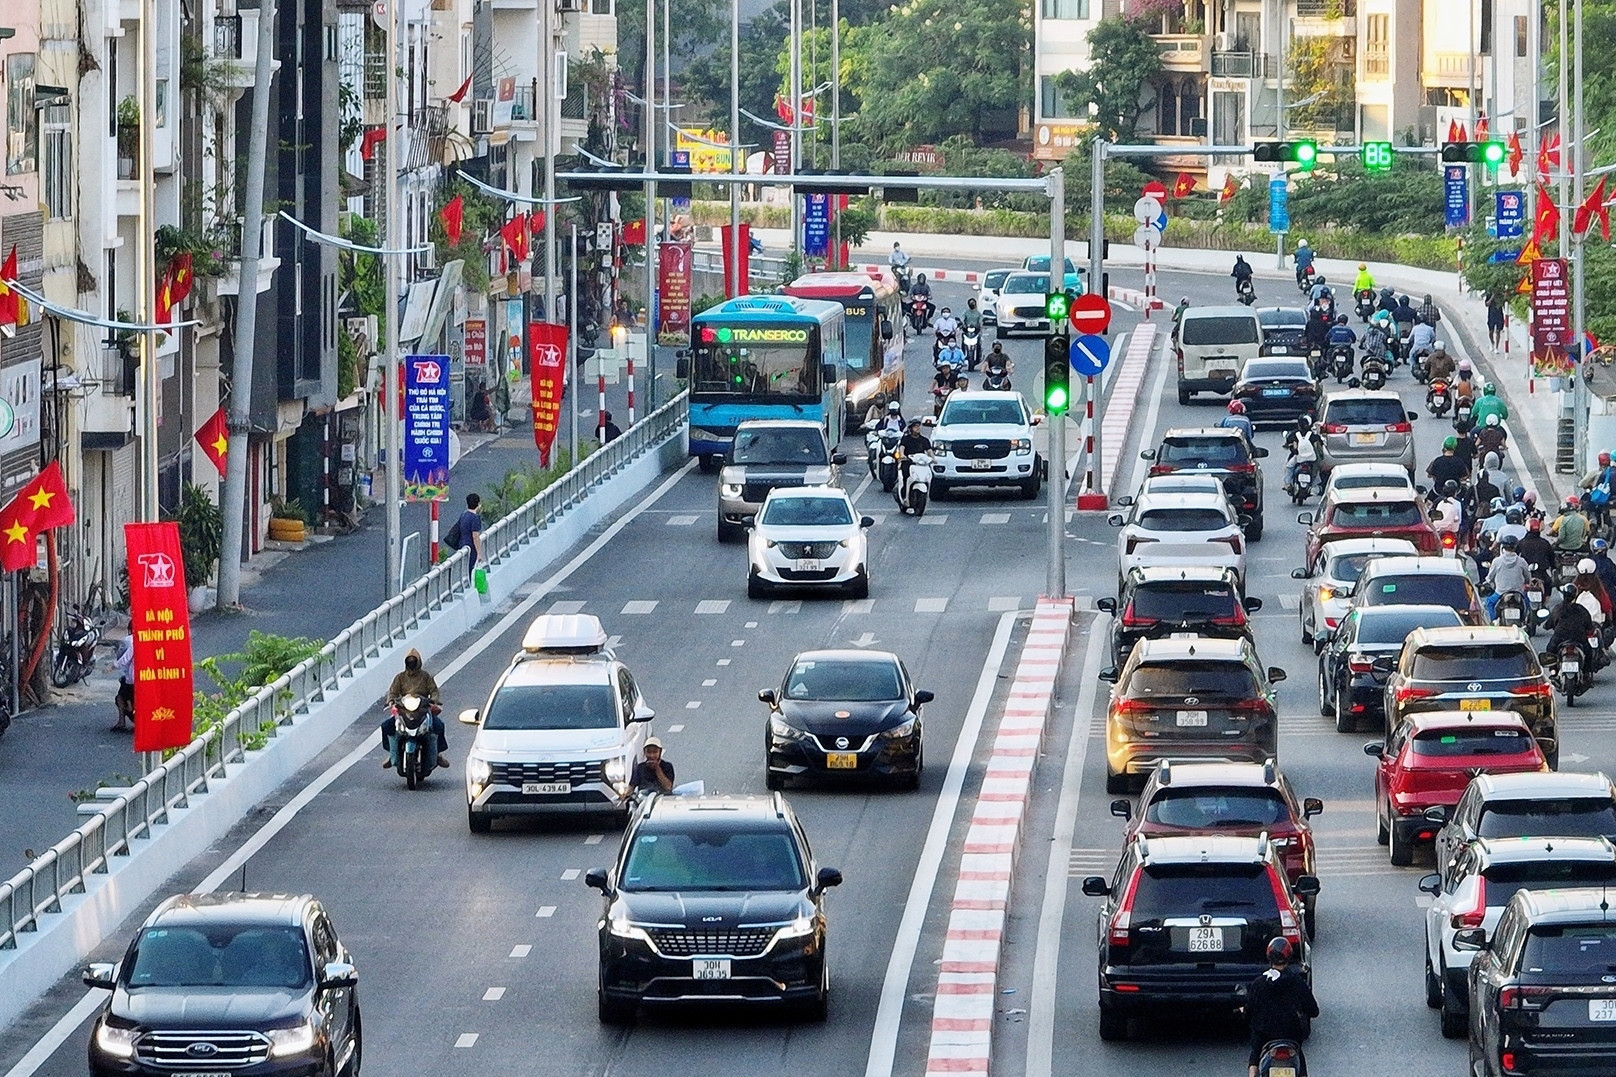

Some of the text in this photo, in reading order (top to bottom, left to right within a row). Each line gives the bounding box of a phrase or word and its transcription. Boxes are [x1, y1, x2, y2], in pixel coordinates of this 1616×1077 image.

[1366, 143, 1390, 165] 86
[732, 329, 807, 342] TRANSERCO
[1197, 929, 1214, 938] 29A
[1190, 940, 1221, 950] 626.88
[1602, 1001, 1616, 1009] 30
